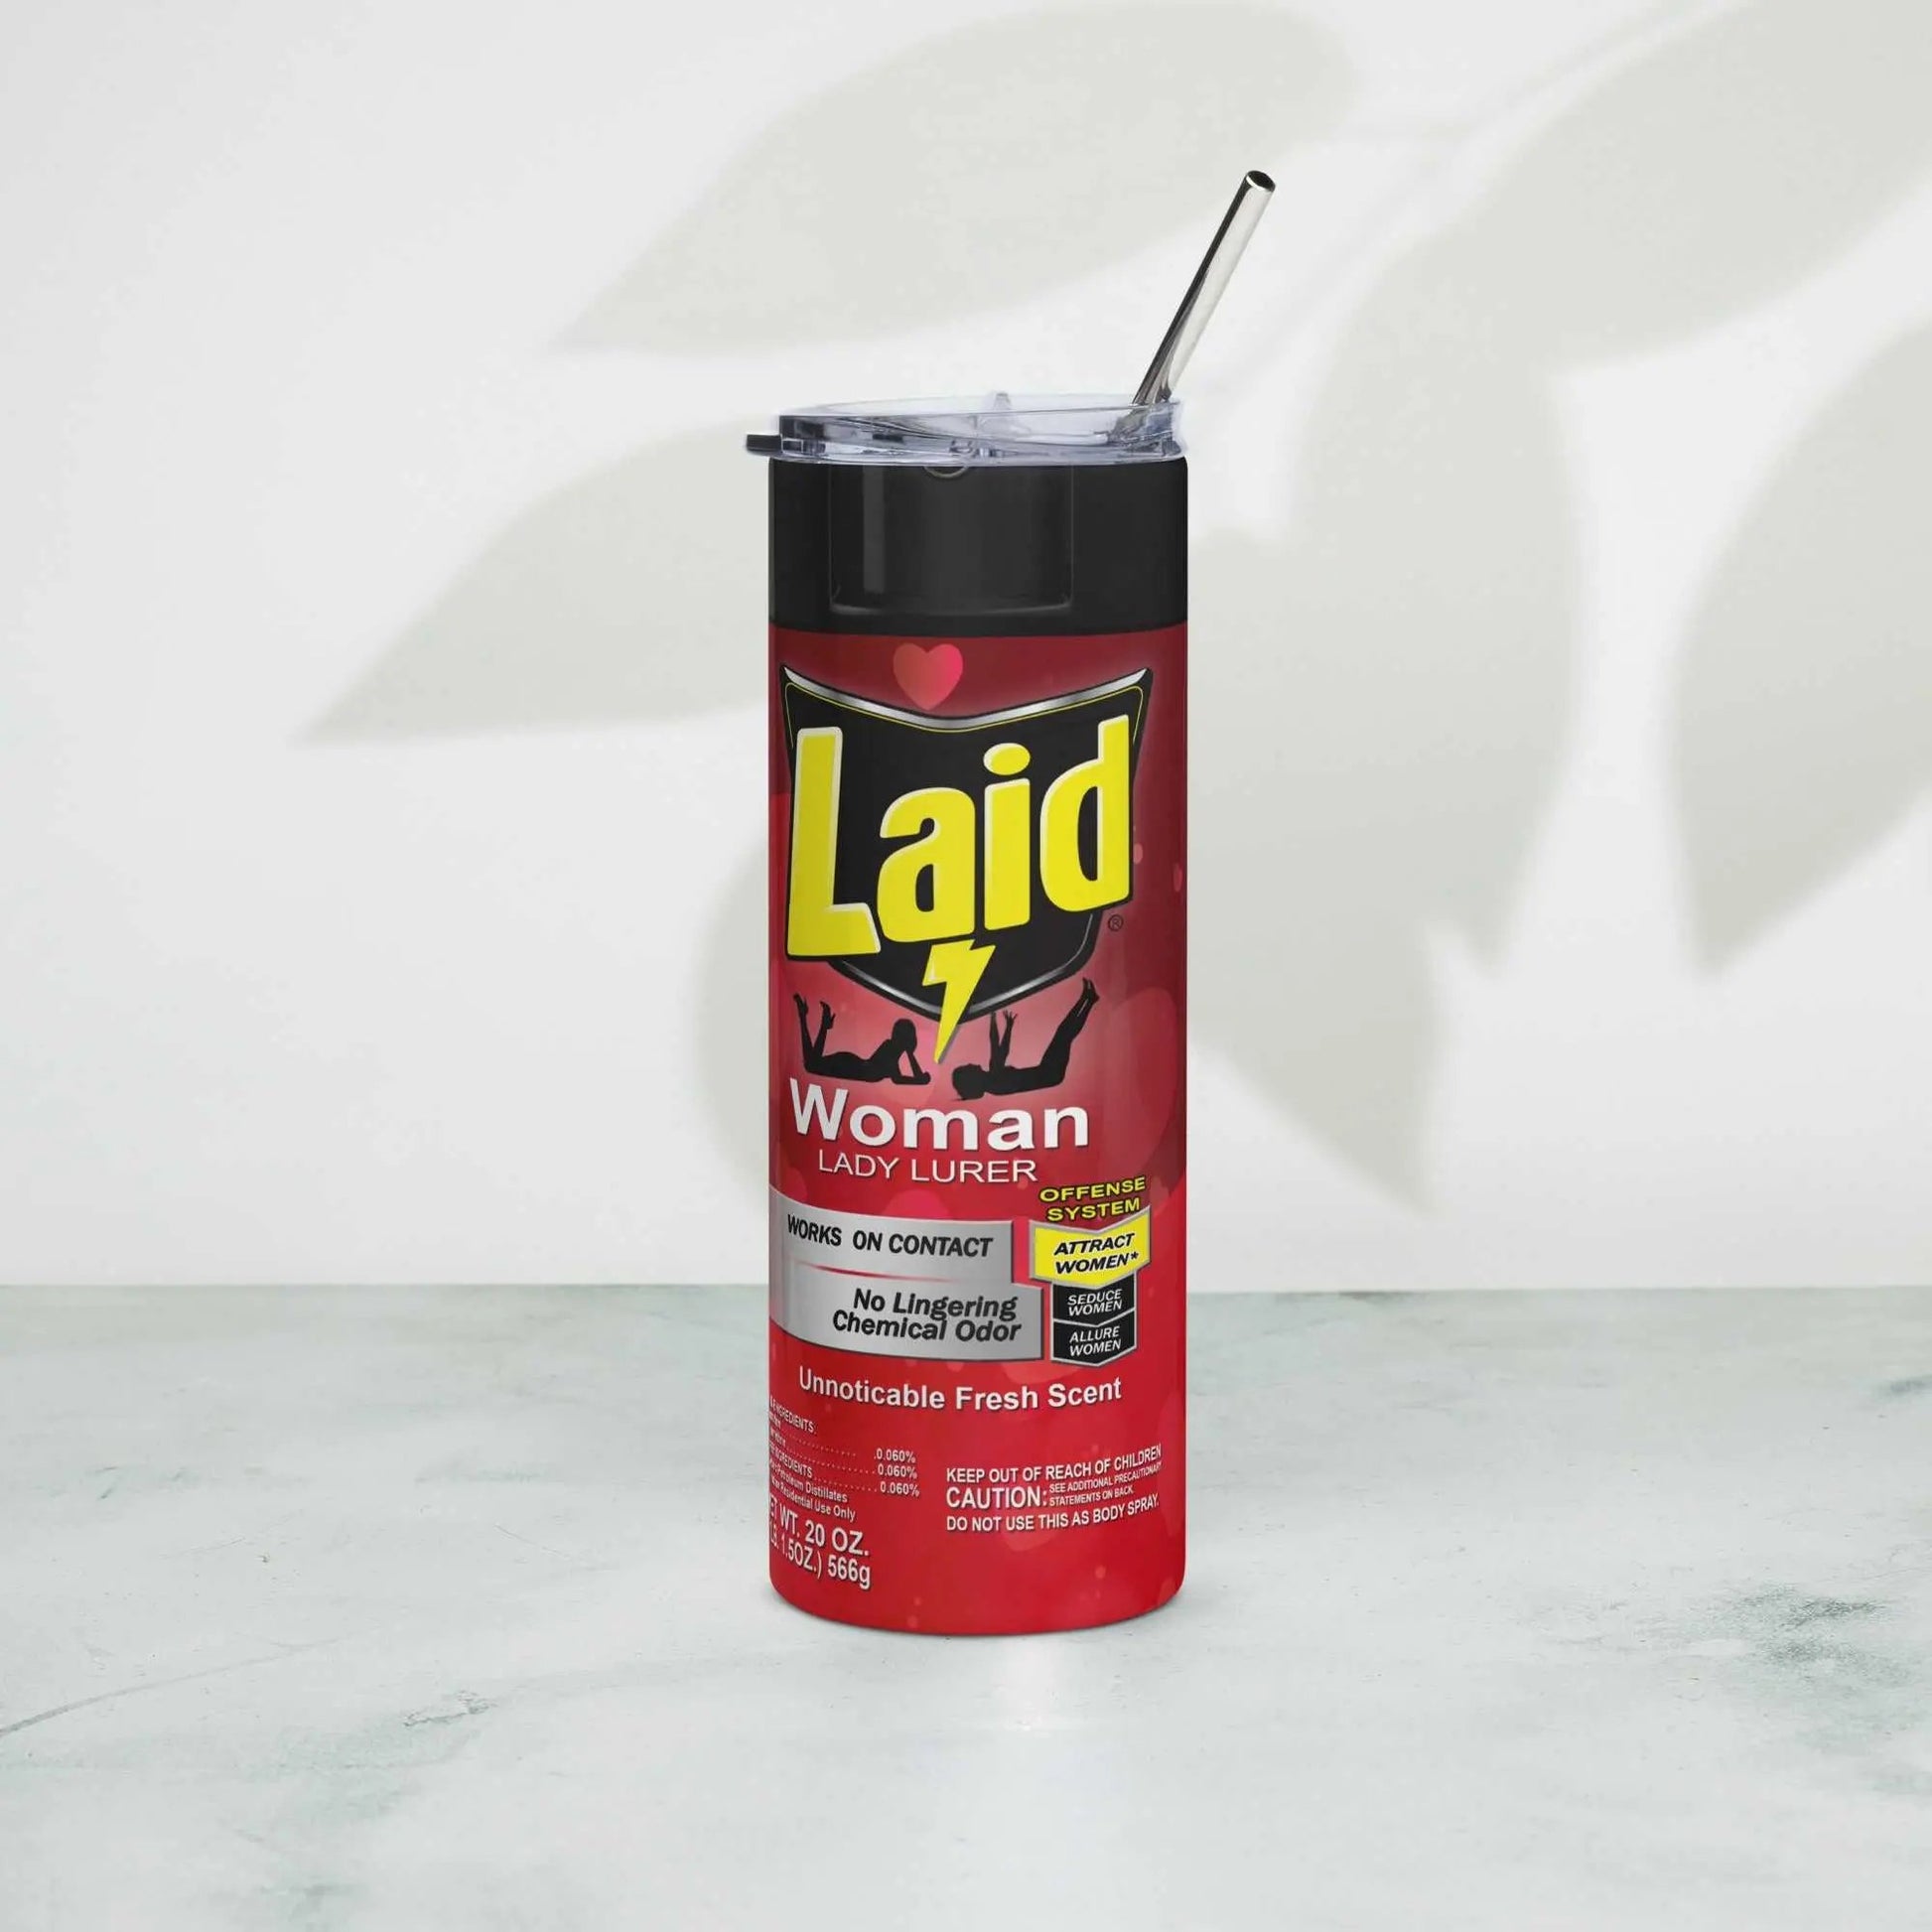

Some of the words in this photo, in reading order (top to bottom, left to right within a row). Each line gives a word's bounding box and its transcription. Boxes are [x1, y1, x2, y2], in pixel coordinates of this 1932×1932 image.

[787, 715, 1130, 956] Laid
[789, 1077, 1089, 1152] Woman
[818, 1149, 900, 1179] LADY
[911, 1159, 1038, 1183] LURER
[1039, 1175, 1147, 1203] OFFENSE
[1047, 1197, 1141, 1222] SYSTEM
[786, 1213, 843, 1247] WORKS
[852, 1230, 883, 1252] ON
[889, 1232, 994, 1258] CONTACT
[1053, 1233, 1136, 1257] ATTRACT
[853, 1288, 886, 1312] No
[893, 1292, 1019, 1321] Lingering
[1067, 1289, 1122, 1306] SEDUCE
[1068, 1300, 1123, 1316] WOMEN
[832, 1310, 948, 1340] Chemical
[955, 1319, 1023, 1341] Odor
[1069, 1325, 1121, 1343] ALLURE
[1069, 1339, 1122, 1357] WOMEN
[798, 1365, 945, 1409] Unnoticable
[955, 1386, 1038, 1411] Fresh
[1047, 1376, 1122, 1408] Scent
[946, 1468, 985, 1483] KEEP
[989, 1467, 1019, 1483] OUT
[1023, 1466, 1041, 1481] OF
[1045, 1461, 1092, 1480] REACH
[1094, 1458, 1112, 1474] OF
[1113, 1444, 1162, 1470] CHILDREN
[805, 1480, 848, 1502] Distillates
[946, 1485, 1047, 1509] CAUTION:
[1049, 1483, 1067, 1494] SEE
[1067, 1477, 1113, 1491] ADDITIONAL
[1049, 1491, 1101, 1507] STATEMENTS
[1102, 1489, 1114, 1500] ON
[814, 1499, 832, 1515] Use
[834, 1504, 856, 1523] Only
[946, 1516, 968, 1531] DO
[972, 1516, 1002, 1532] NOT
[1006, 1515, 1035, 1531] USE
[1038, 1512, 1069, 1529] THIS
[1071, 1510, 1090, 1526] AS
[1093, 1503, 1126, 1524] BODY
[1127, 1492, 1160, 1516] SPRAY.
[779, 1503, 800, 1538] WT.
[805, 1519, 826, 1548] 20
[831, 1527, 870, 1557] OZ.
[827, 1554, 872, 1590] 566g
